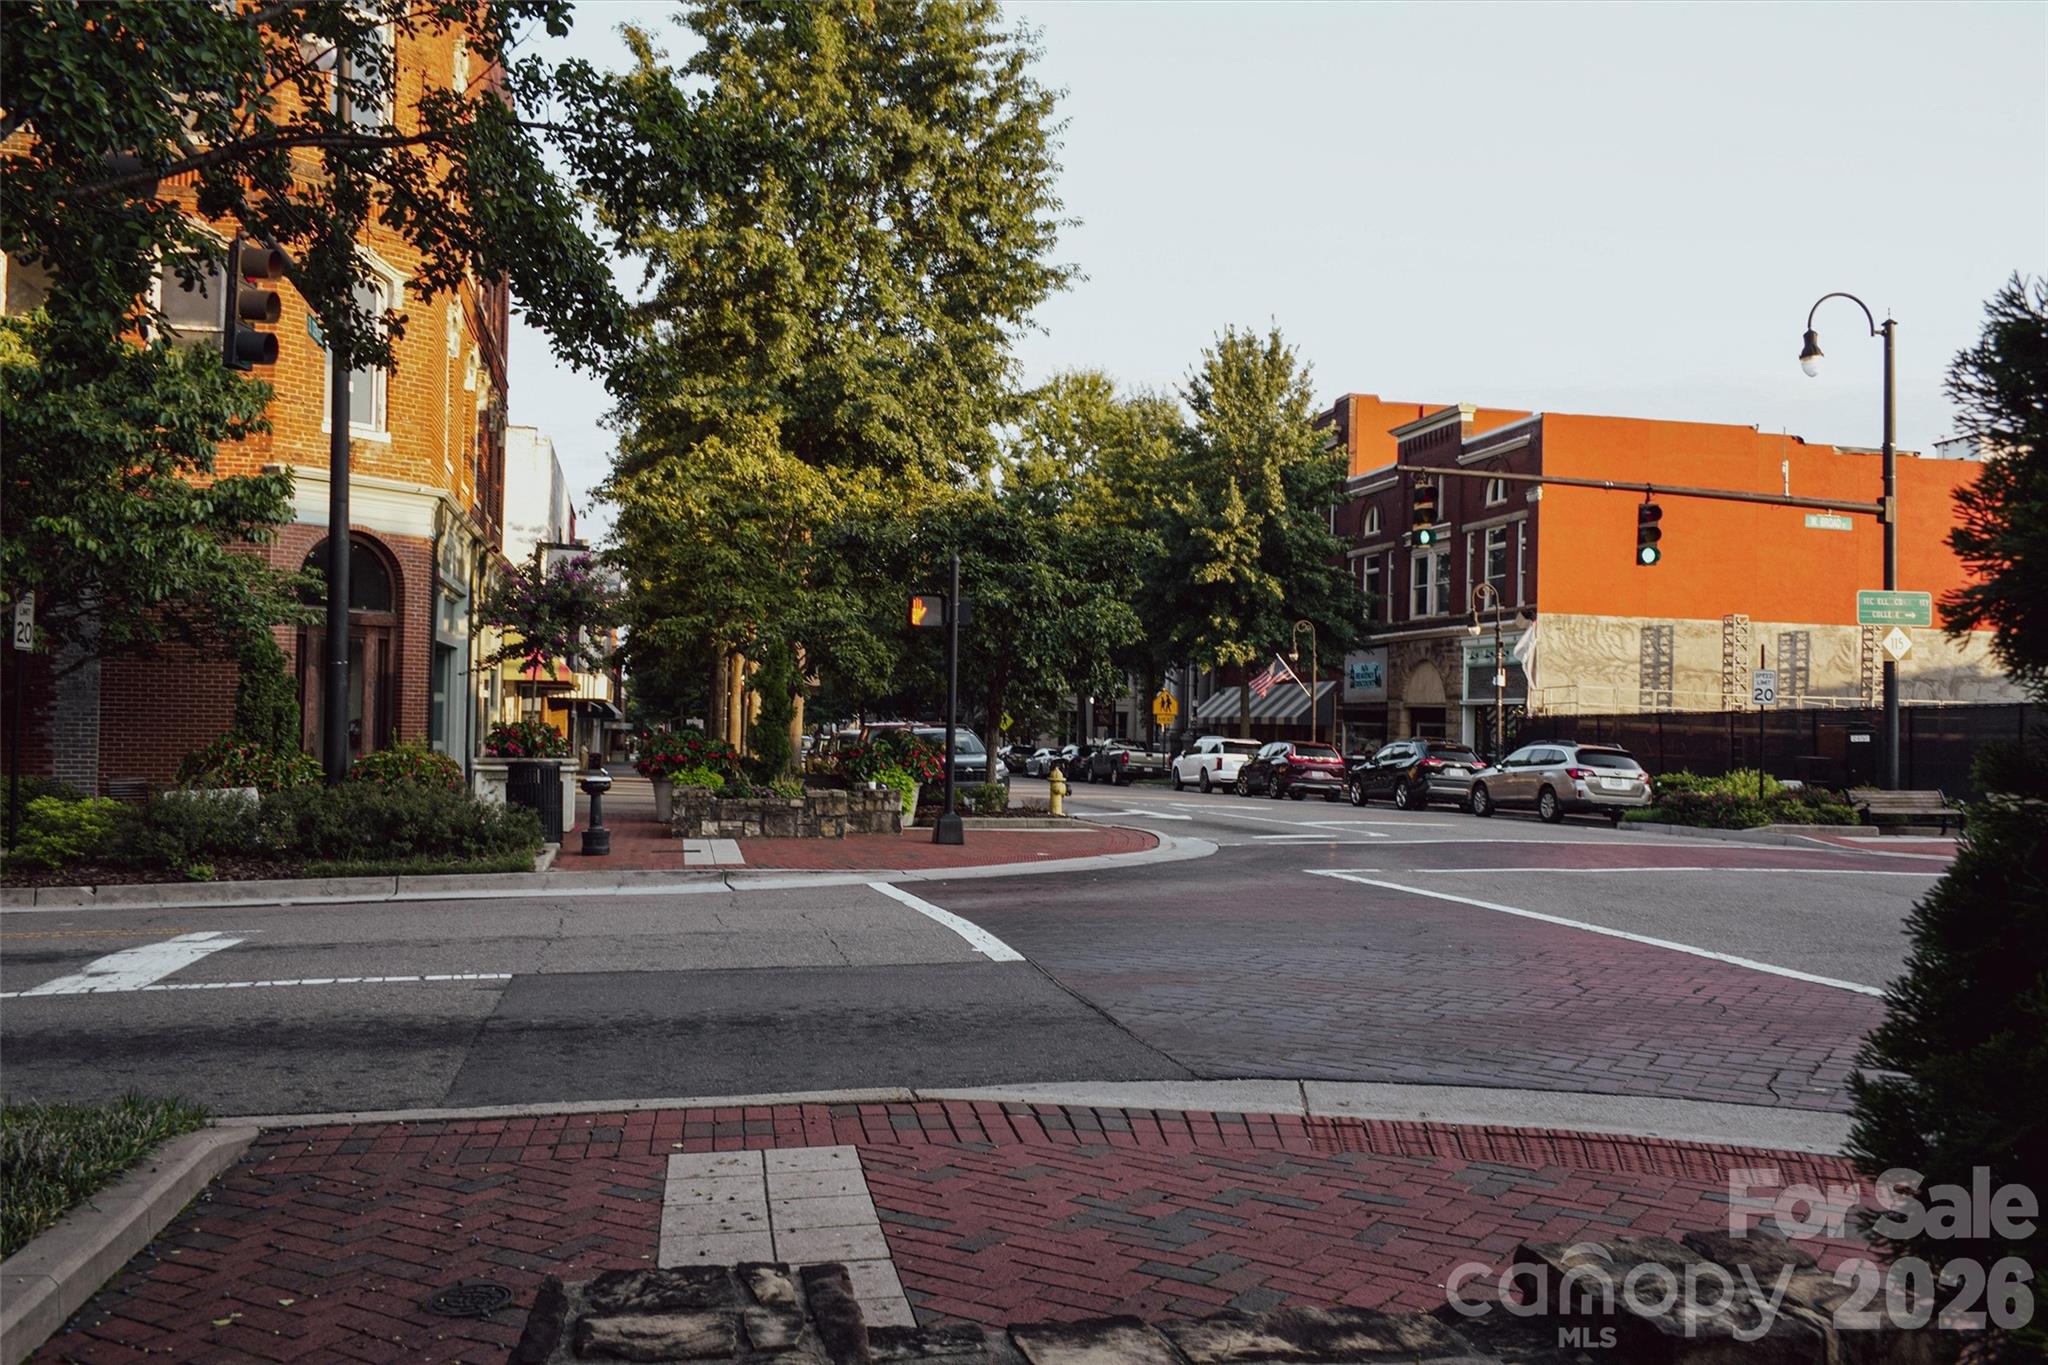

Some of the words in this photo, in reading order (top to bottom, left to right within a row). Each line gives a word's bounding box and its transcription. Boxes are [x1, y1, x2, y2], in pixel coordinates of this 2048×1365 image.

[17, 621, 32, 644] 20
[1890, 637, 1904, 650] 115
[1754, 687, 1774, 701] 20
